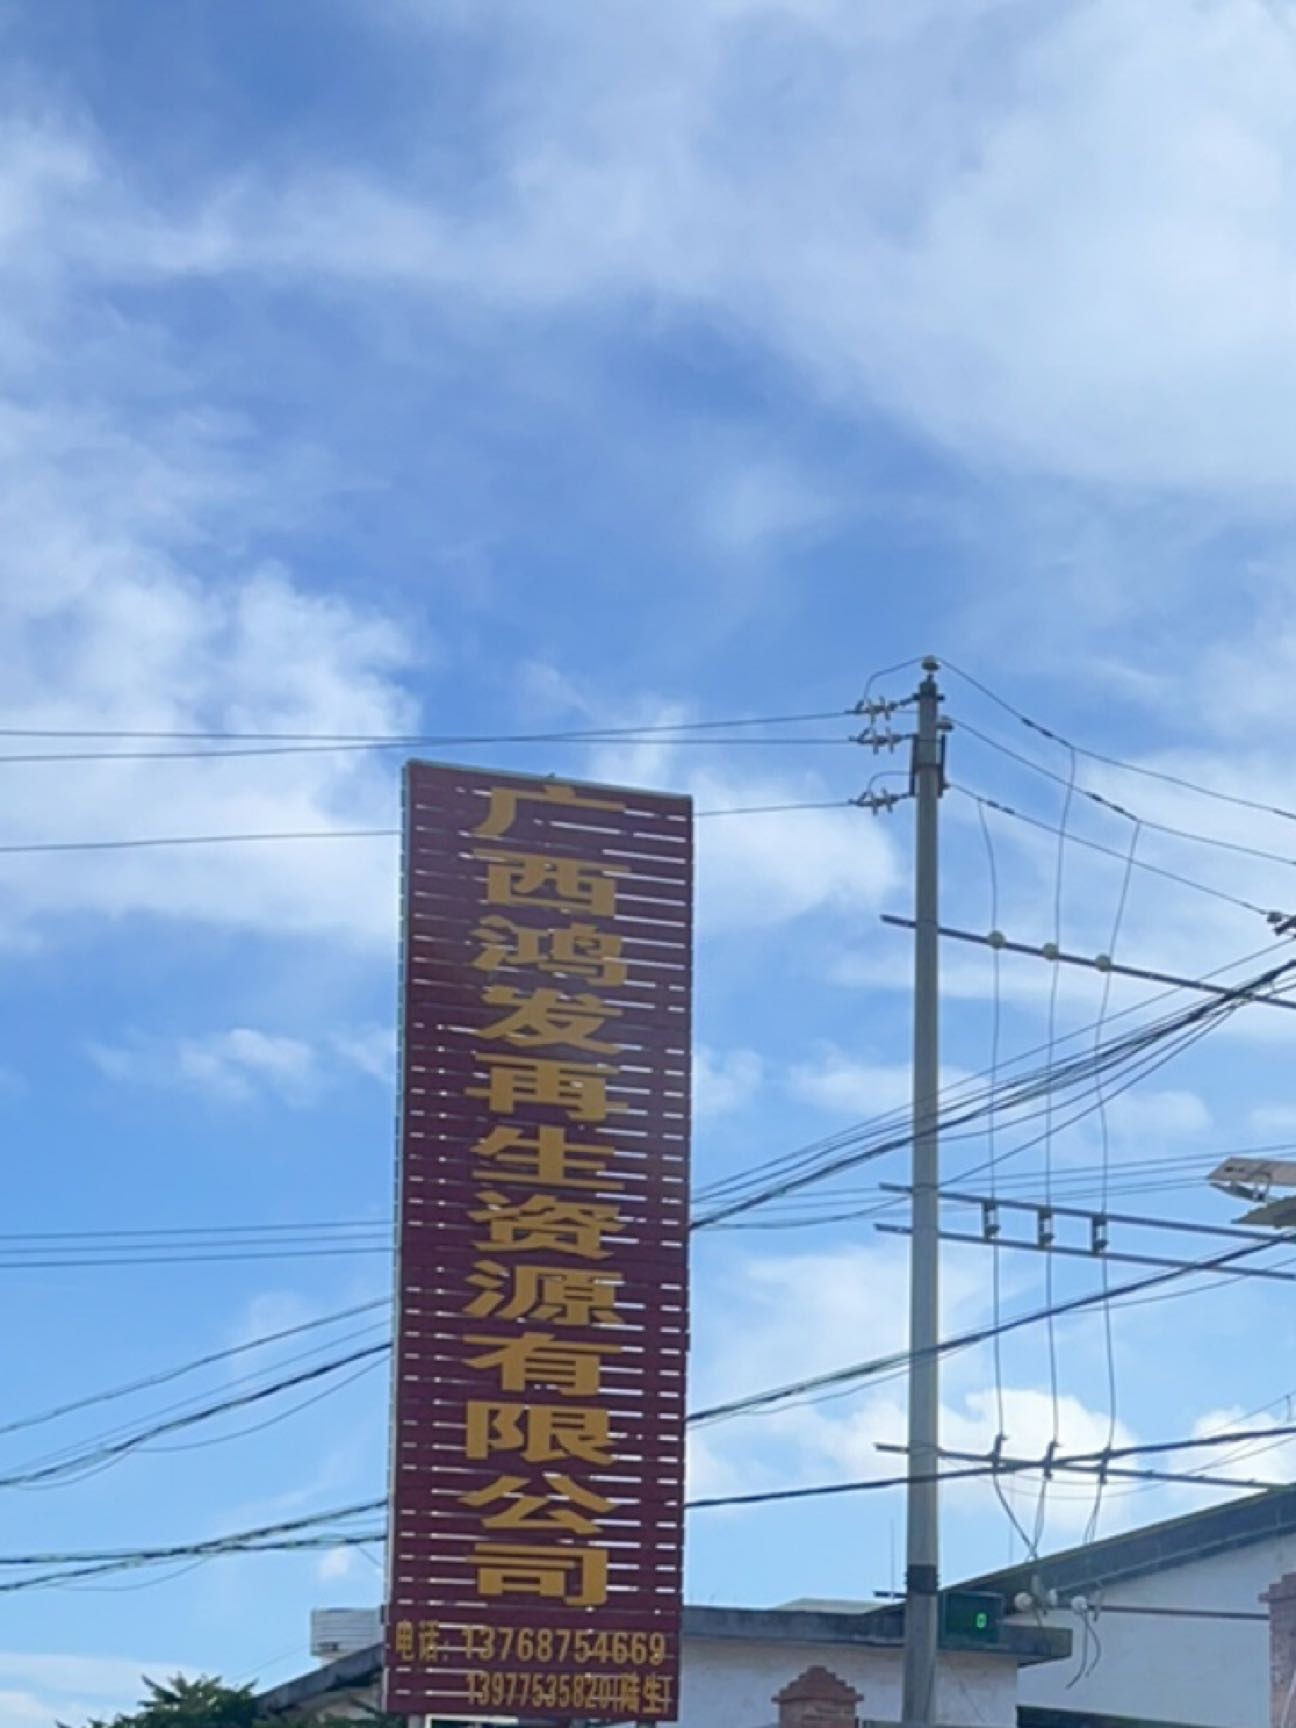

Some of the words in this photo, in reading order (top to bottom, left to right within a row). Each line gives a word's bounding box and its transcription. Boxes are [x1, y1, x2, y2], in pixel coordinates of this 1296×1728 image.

[457, 783, 631, 1608] 广西鸿发再生资源有限公司
